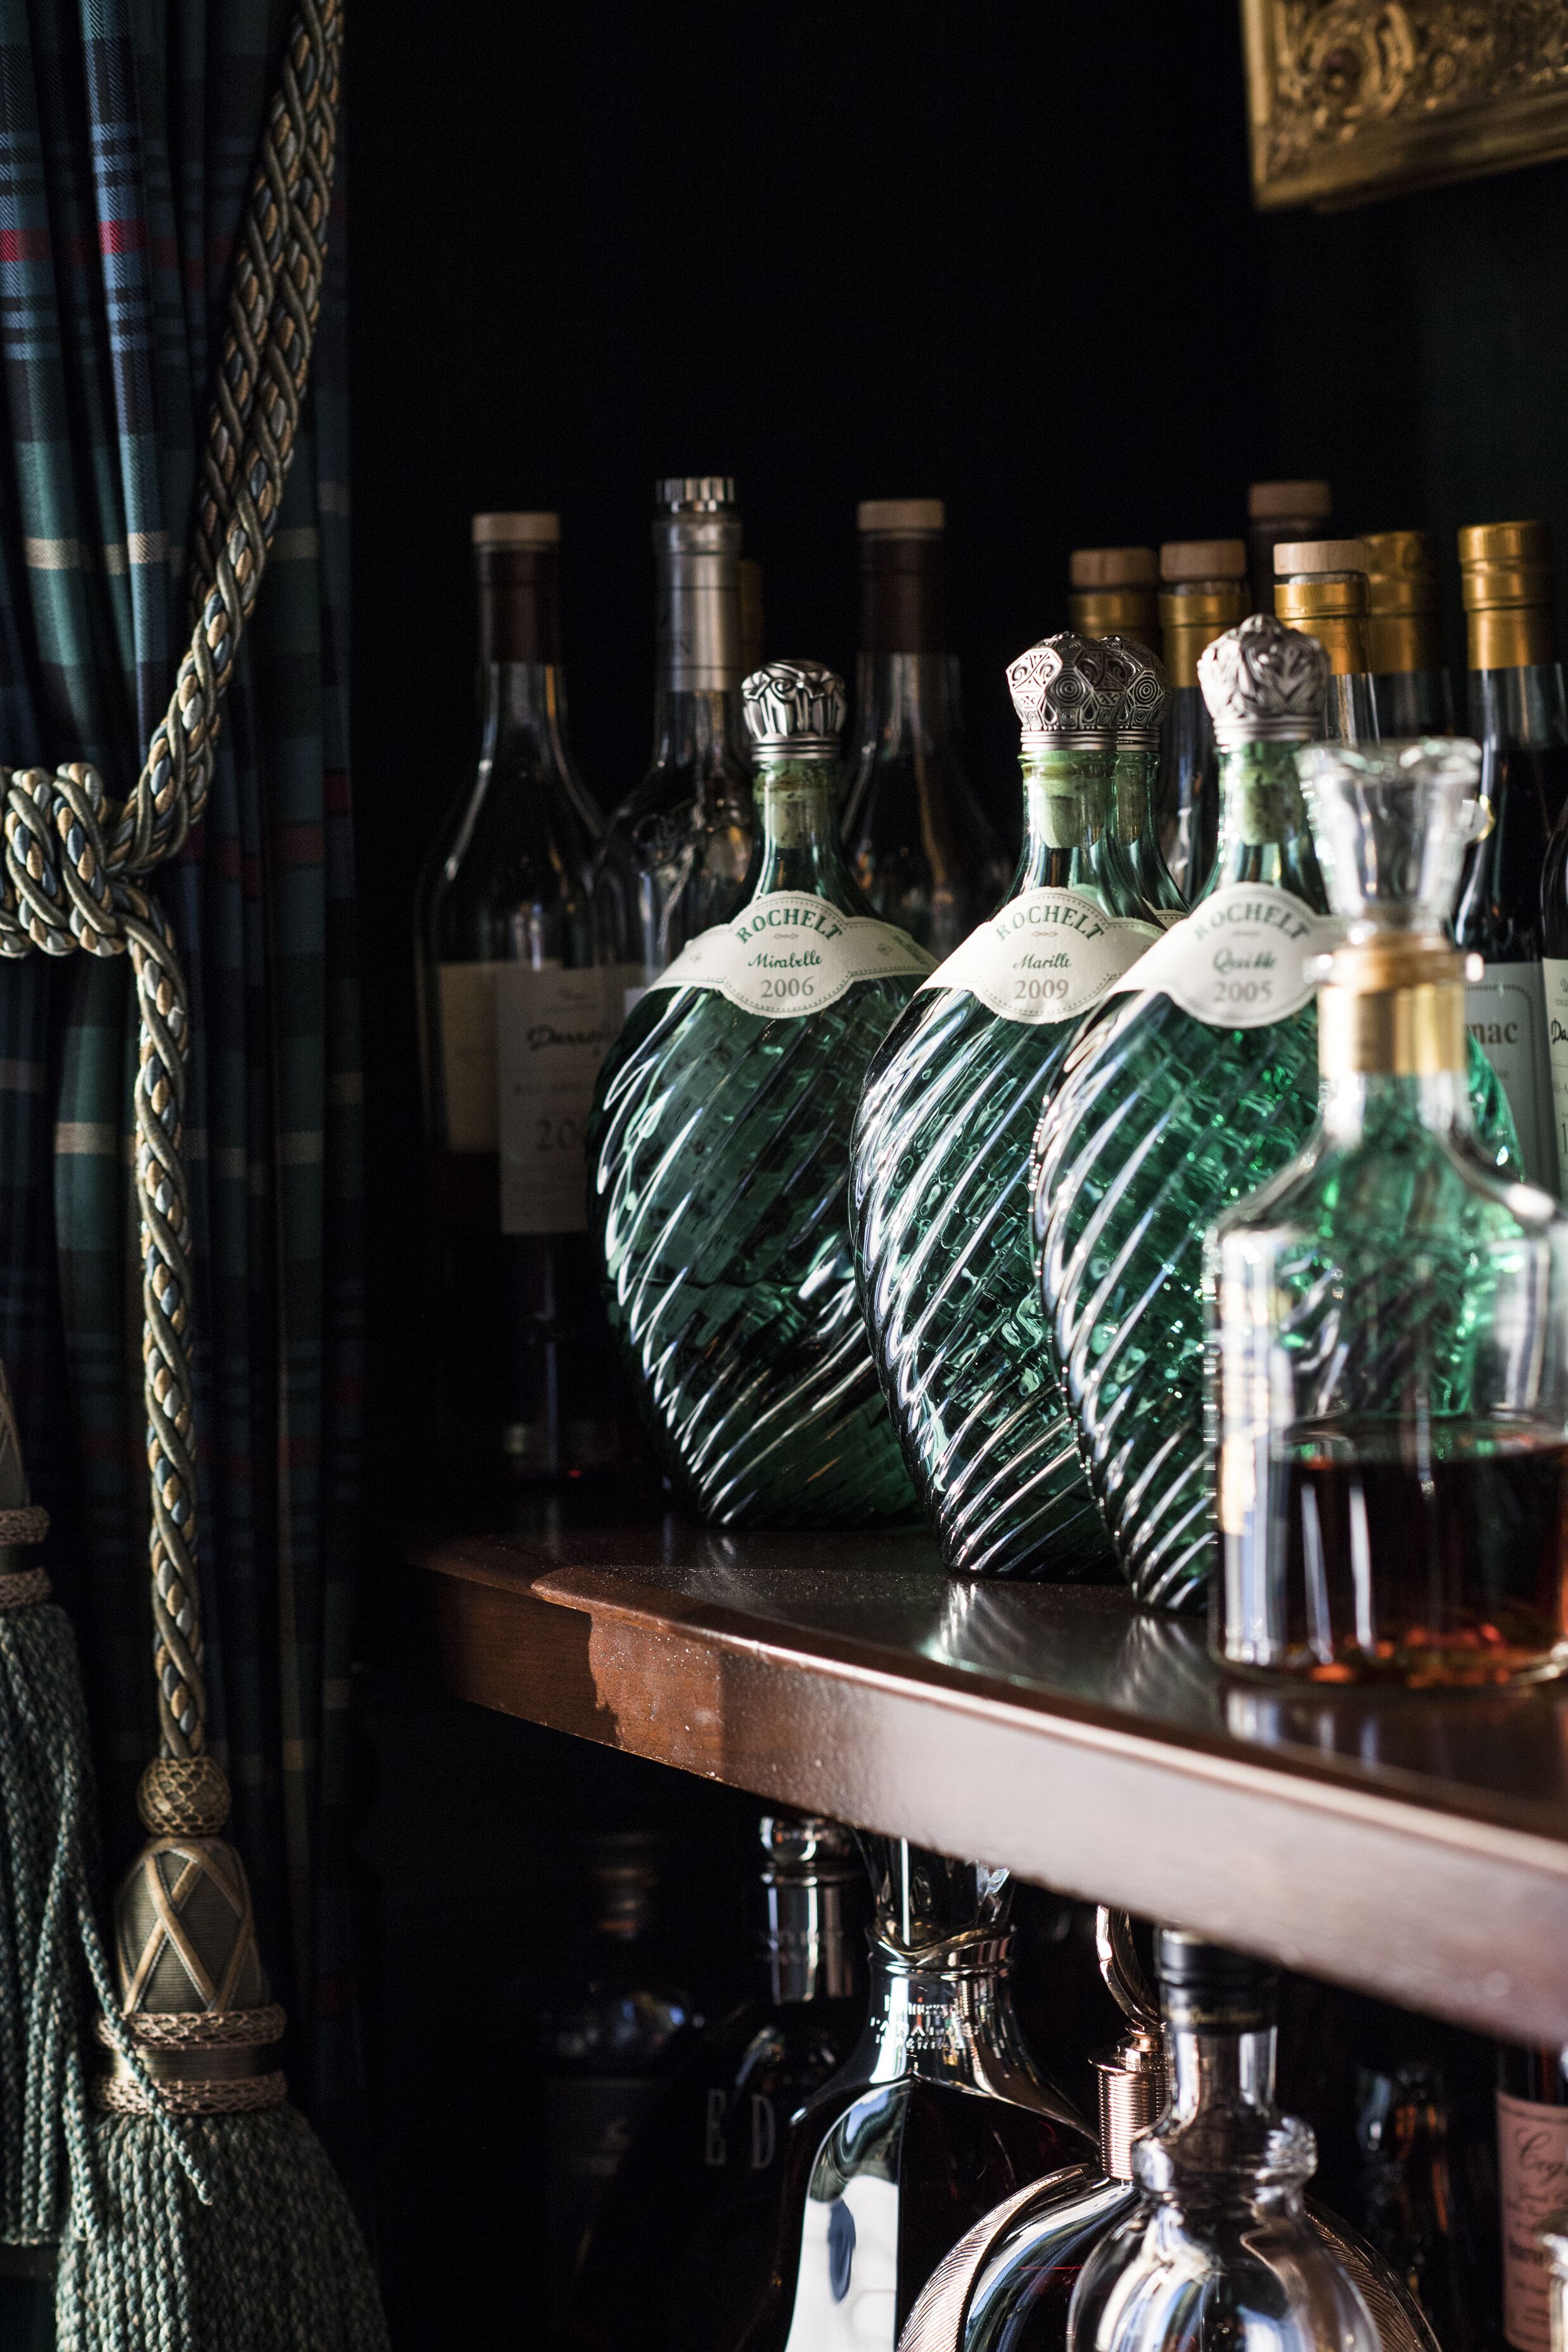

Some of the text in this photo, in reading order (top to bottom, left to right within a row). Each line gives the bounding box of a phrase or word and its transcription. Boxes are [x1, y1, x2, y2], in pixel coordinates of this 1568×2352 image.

[735, 908, 843, 944] ROCHELT
[996, 905, 1104, 942] ROCHELT
[1194, 902, 1310, 940] ROCHELT
[748, 950, 822, 968] Mirabelle
[1013, 954, 1072, 969] Marille
[760, 976, 814, 999] 2006
[1014, 980, 1069, 1000] 2009
[1214, 981, 1273, 1002] 2005
[1470, 1021, 1519, 1044] nac
